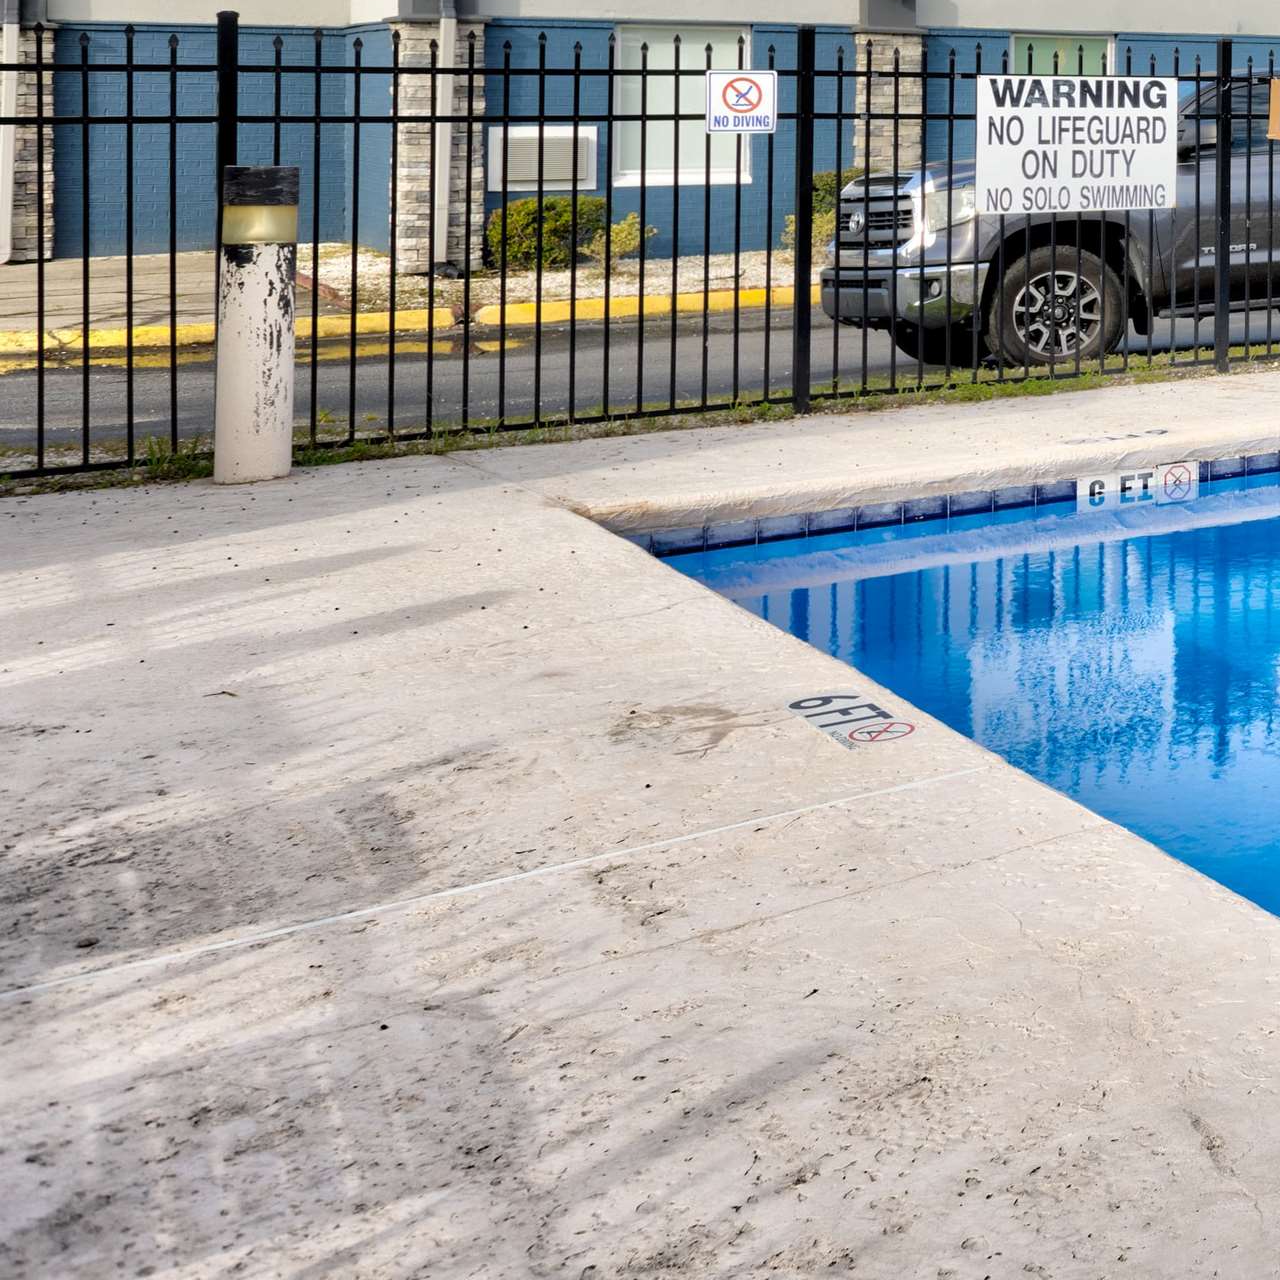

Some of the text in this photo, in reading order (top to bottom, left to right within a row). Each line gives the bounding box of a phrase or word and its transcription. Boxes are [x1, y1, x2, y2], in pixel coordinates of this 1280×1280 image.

[990, 78, 1167, 109] WARNING
[713, 115, 770, 128] NO DIVING
[988, 115, 1167, 146] NO LIFEGUARD
[1022, 149, 1136, 180] ON DUTY
[986, 184, 1166, 212] NO SOLO SWIMMING
